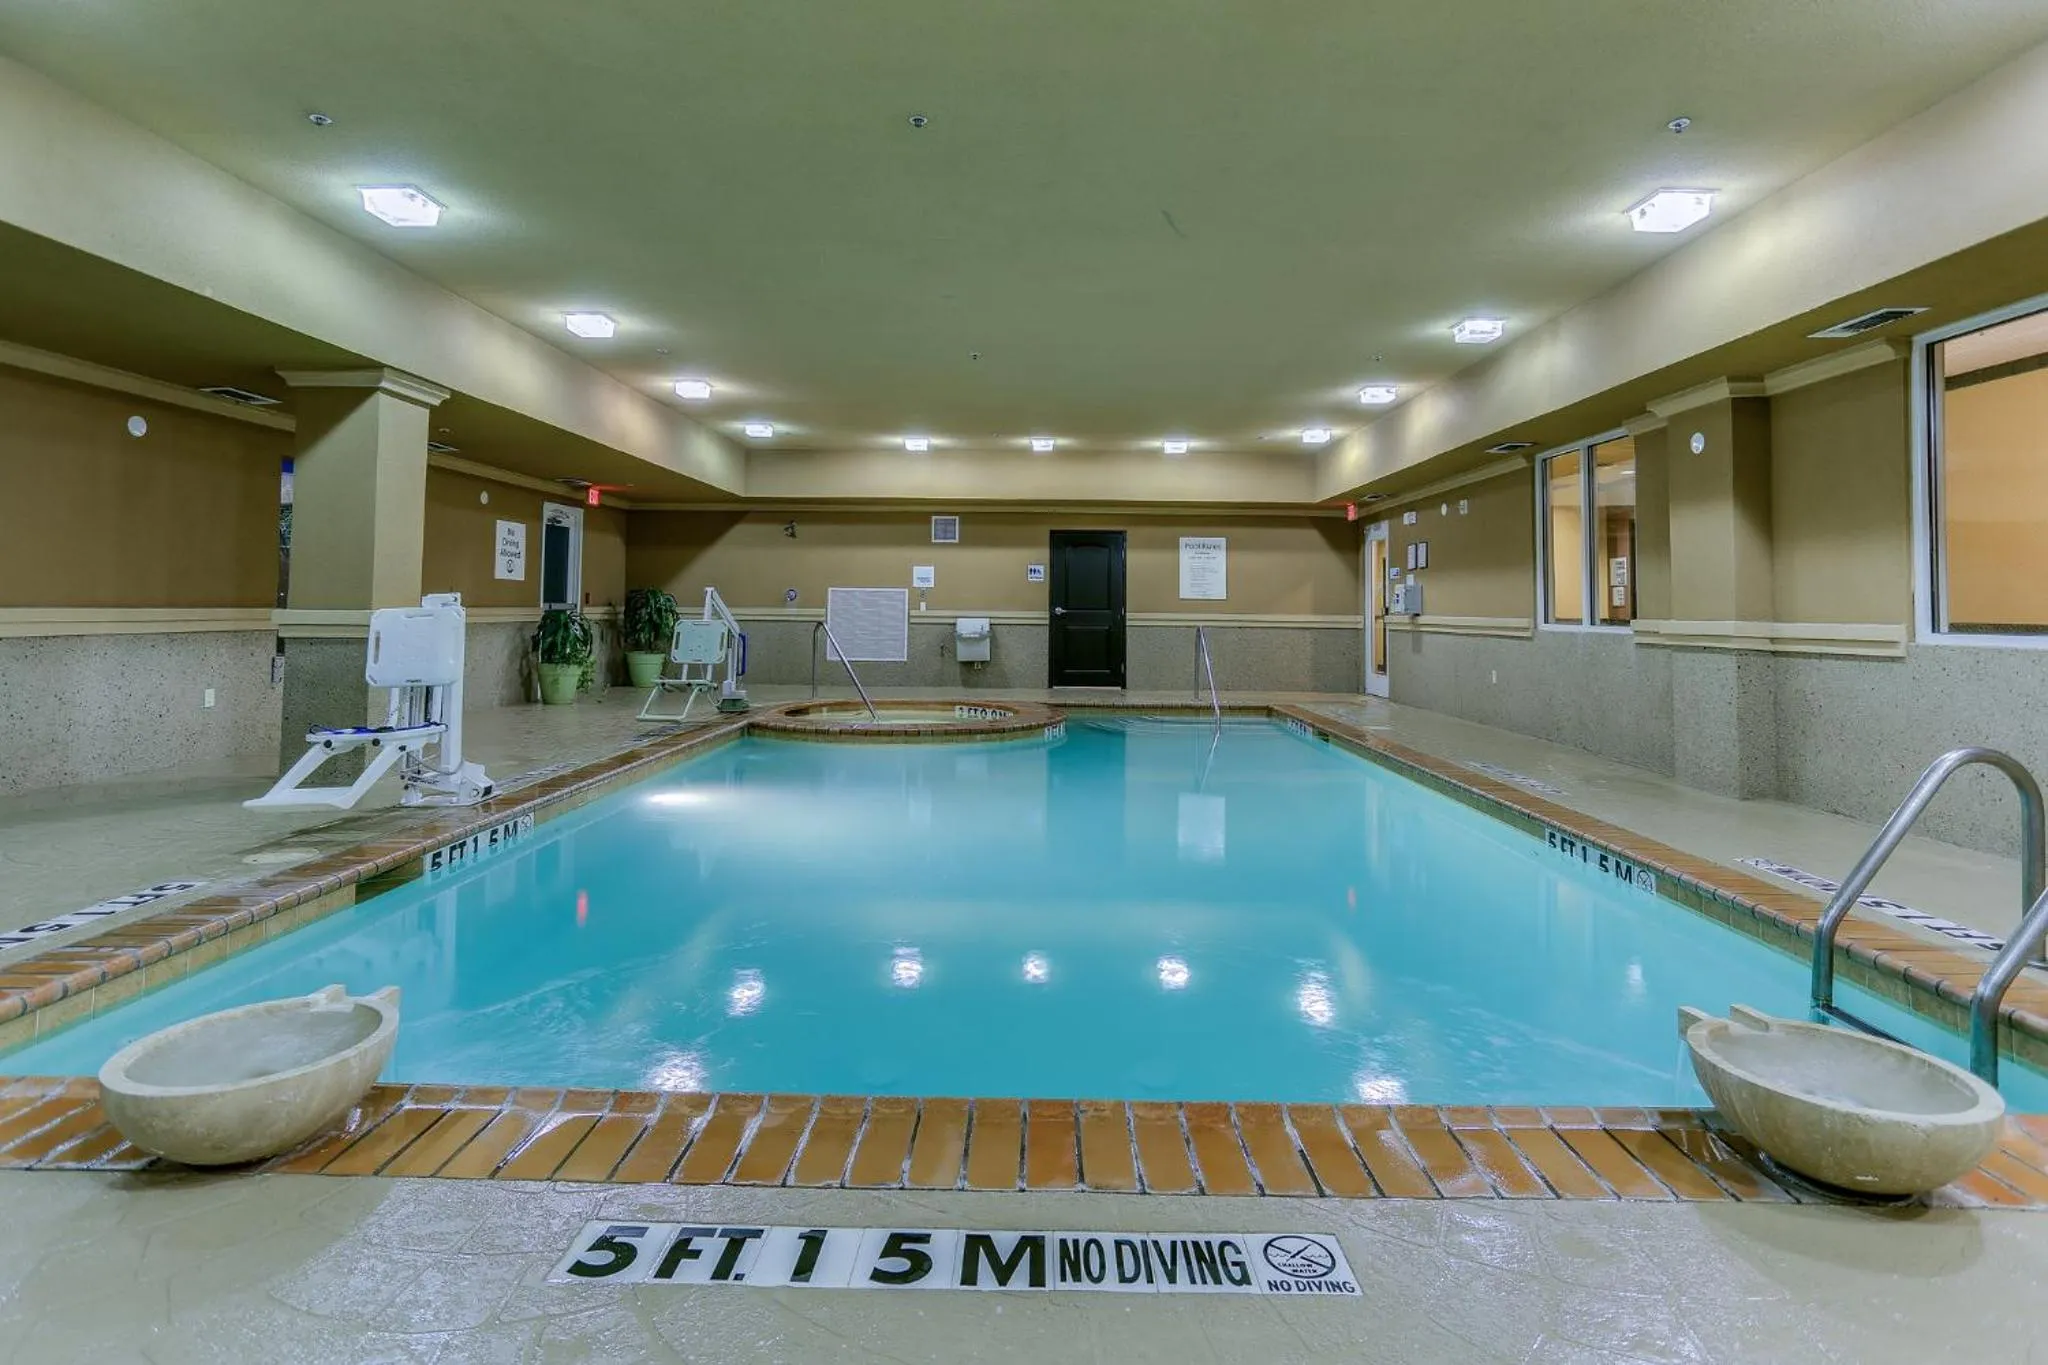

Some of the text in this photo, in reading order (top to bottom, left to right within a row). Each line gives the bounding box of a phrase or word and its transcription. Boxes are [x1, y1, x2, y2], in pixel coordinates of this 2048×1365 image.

[430, 850, 443, 872] 5
[473, 835, 479, 854] 1
[488, 828, 499, 847] 5
[503, 820, 518, 840] M
[1548, 831, 1557, 849] 5
[1581, 845, 1587, 863] 1
[1599, 853, 1609, 873] 5
[1615, 859, 1633, 884] M
[566, 1225, 1252, 1288] 5 FT. 1 5 M NO DIVING
[1267, 1279, 1356, 1294] NO DIVING
